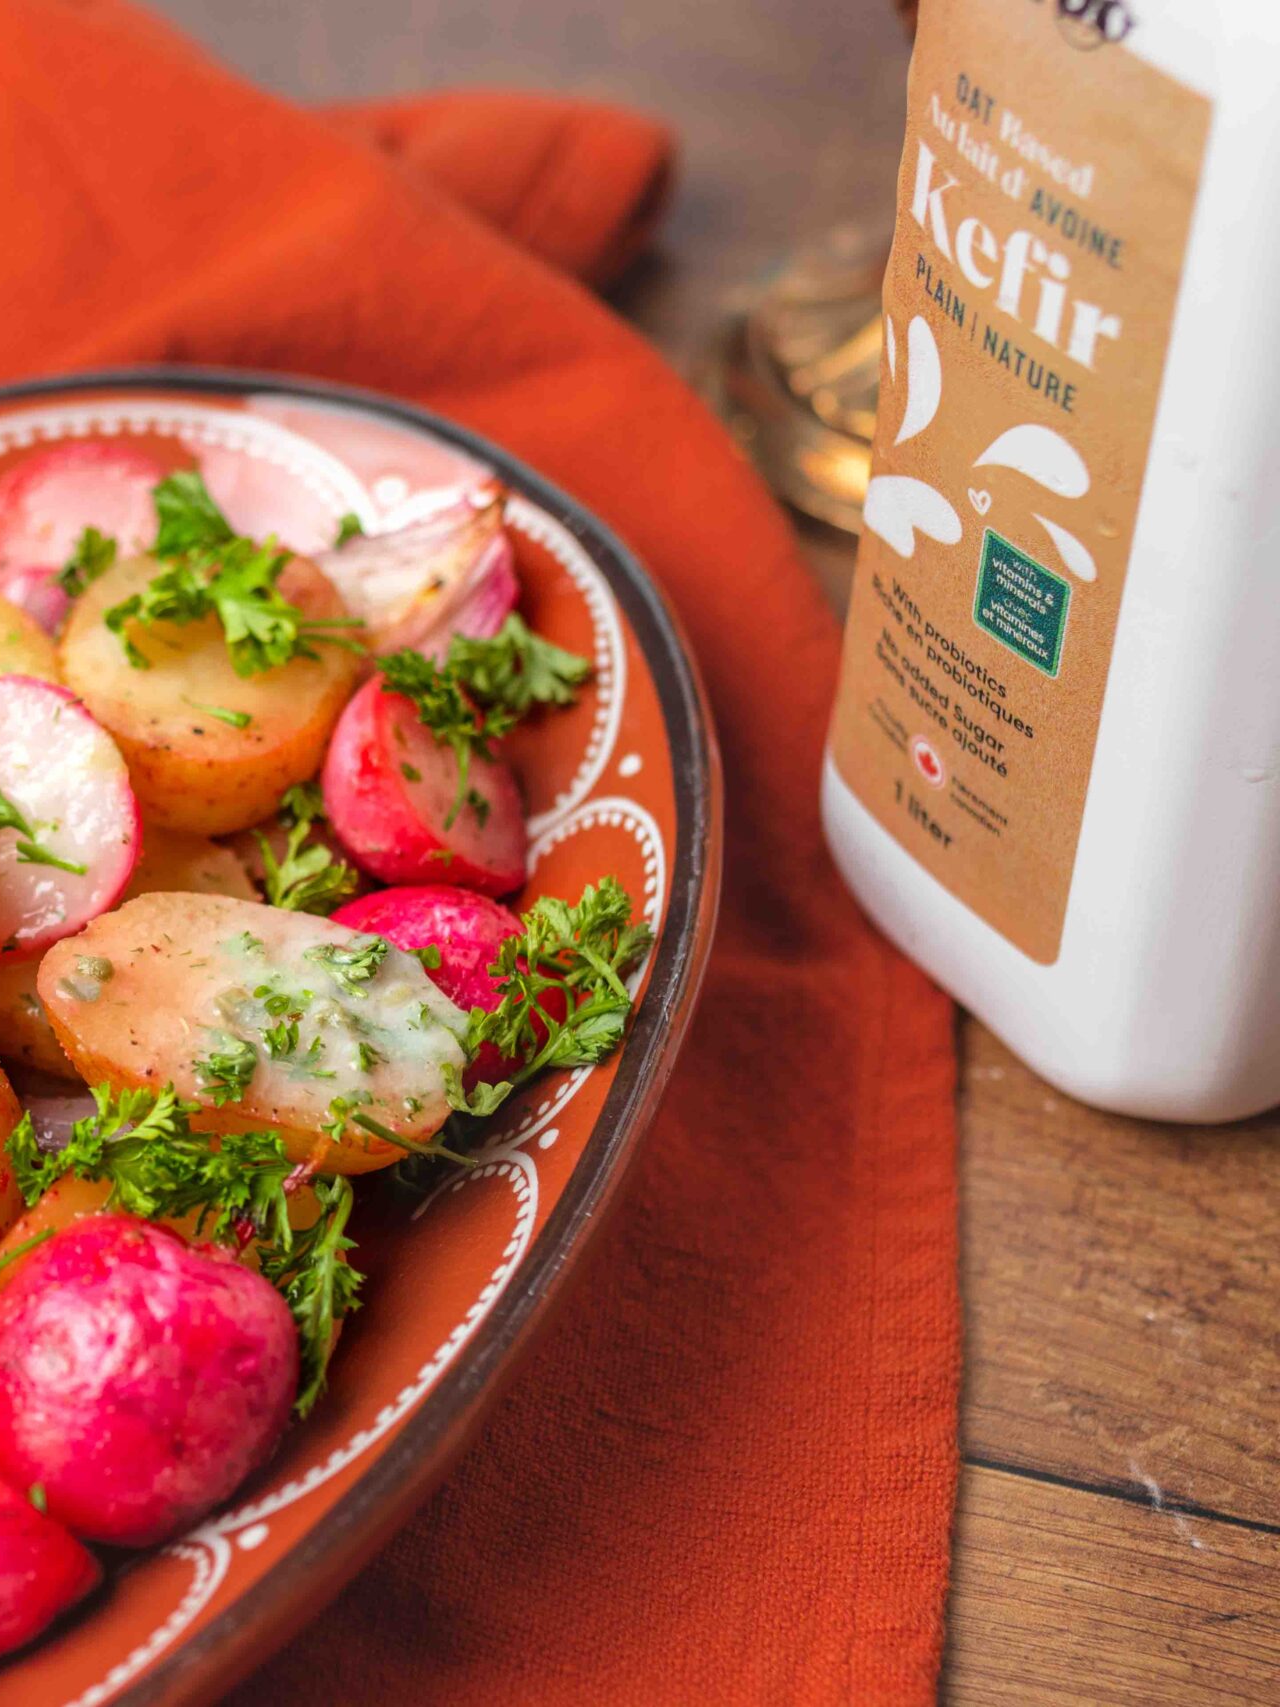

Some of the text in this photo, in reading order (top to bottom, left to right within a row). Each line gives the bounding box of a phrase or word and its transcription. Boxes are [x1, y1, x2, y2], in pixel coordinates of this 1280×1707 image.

[924, 91, 955, 141] Au
[958, 122, 998, 182] lait
[1029, 187, 1124, 269] AVOINE
[957, 73, 1094, 198] OAT Based
[909, 138, 1121, 371] Kefir
[916, 253, 965, 328] PLAIN
[983, 325, 1078, 413] NATURE
[982, 608, 994, 622] et
[992, 557, 1054, 607] vitamins &
[996, 573, 1047, 615] minerals
[1004, 598, 1032, 623] avec
[1012, 559, 1037, 581] with
[893, 578, 1007, 699] With probiotics
[990, 599, 1045, 644] vitamines
[902, 656, 949, 710] added
[953, 704, 1005, 754] Sugar
[907, 624, 923, 648] en
[926, 645, 1034, 739] probiotiques
[910, 685, 948, 730] sucre
[952, 727, 1008, 779] ajouté
[908, 793, 952, 849] liter
